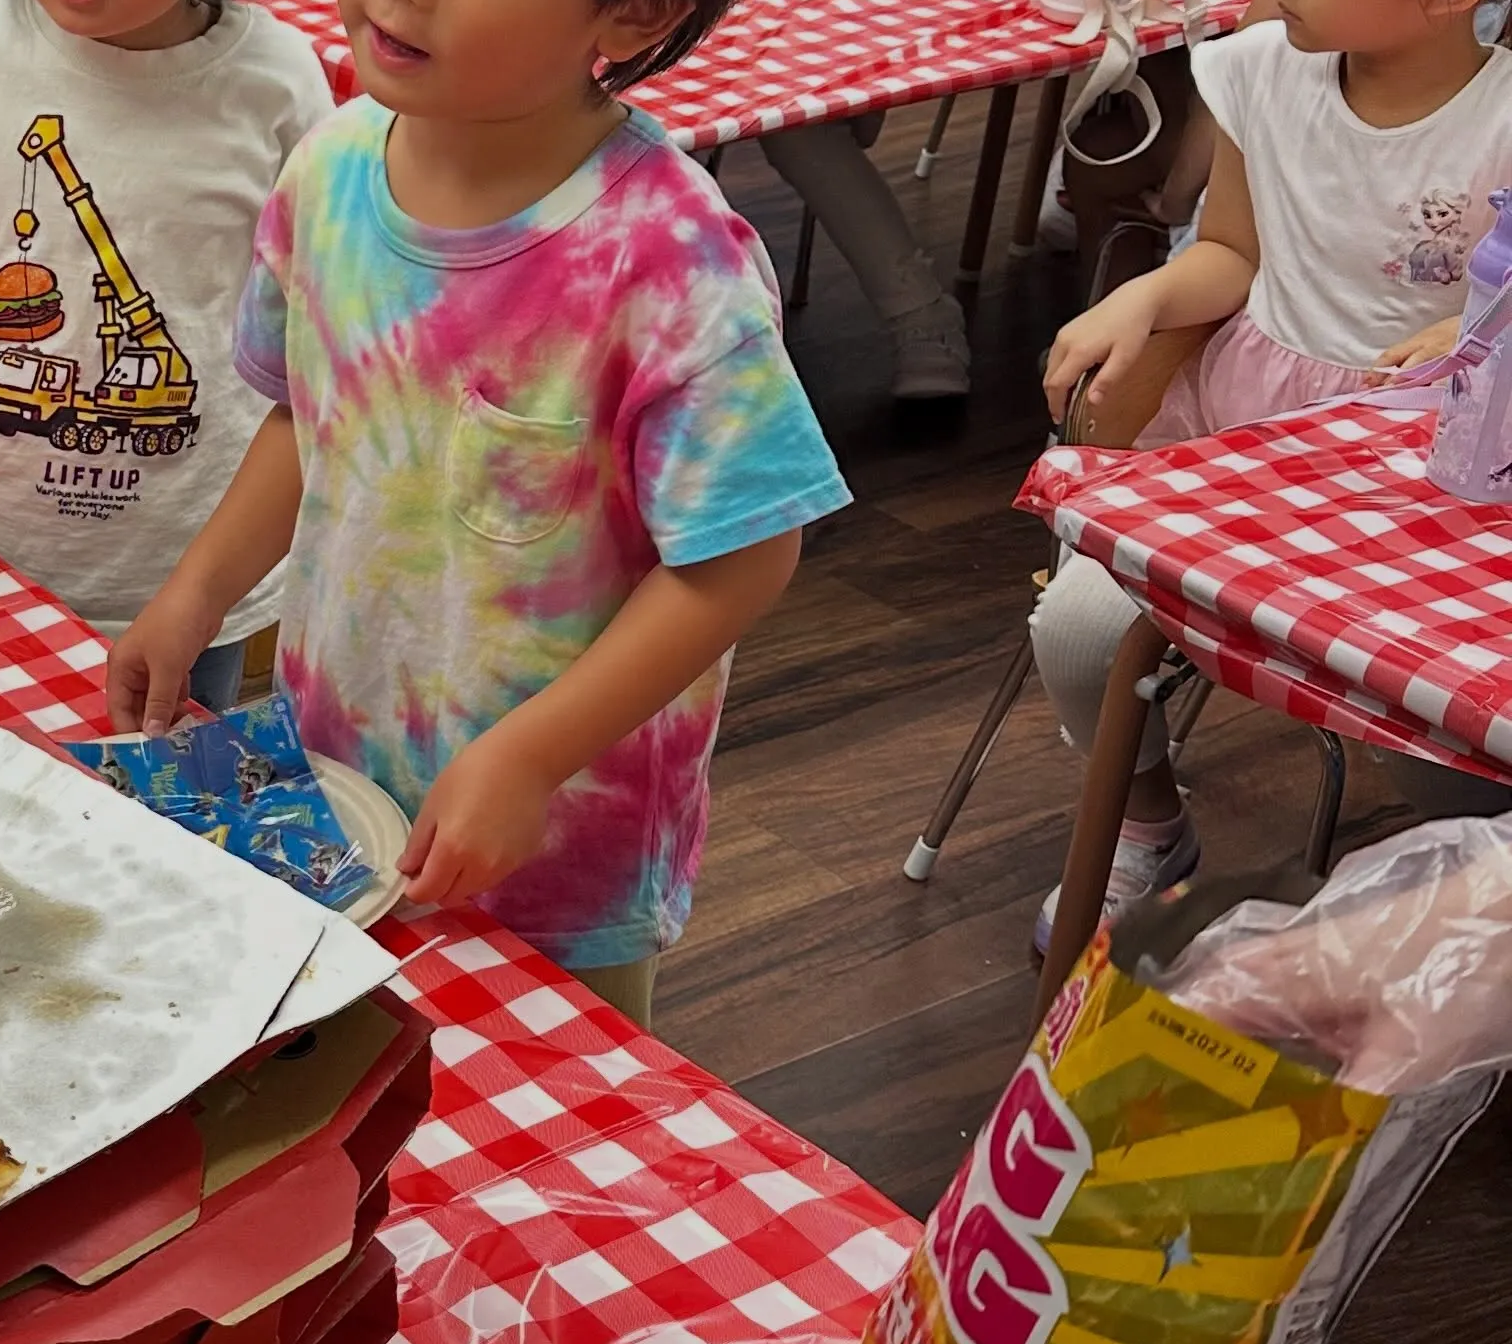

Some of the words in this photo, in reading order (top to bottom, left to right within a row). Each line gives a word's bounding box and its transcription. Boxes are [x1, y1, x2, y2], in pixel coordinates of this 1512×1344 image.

[44, 461, 103, 488] LIFT
[109, 469, 140, 490] UP
[35, 484, 71, 499] Various
[74, 489, 113, 502] vehicles
[115, 493, 141, 502] work
[58, 498, 73, 507] for
[75, 500, 125, 511] everyone
[58, 508, 88, 519] every
